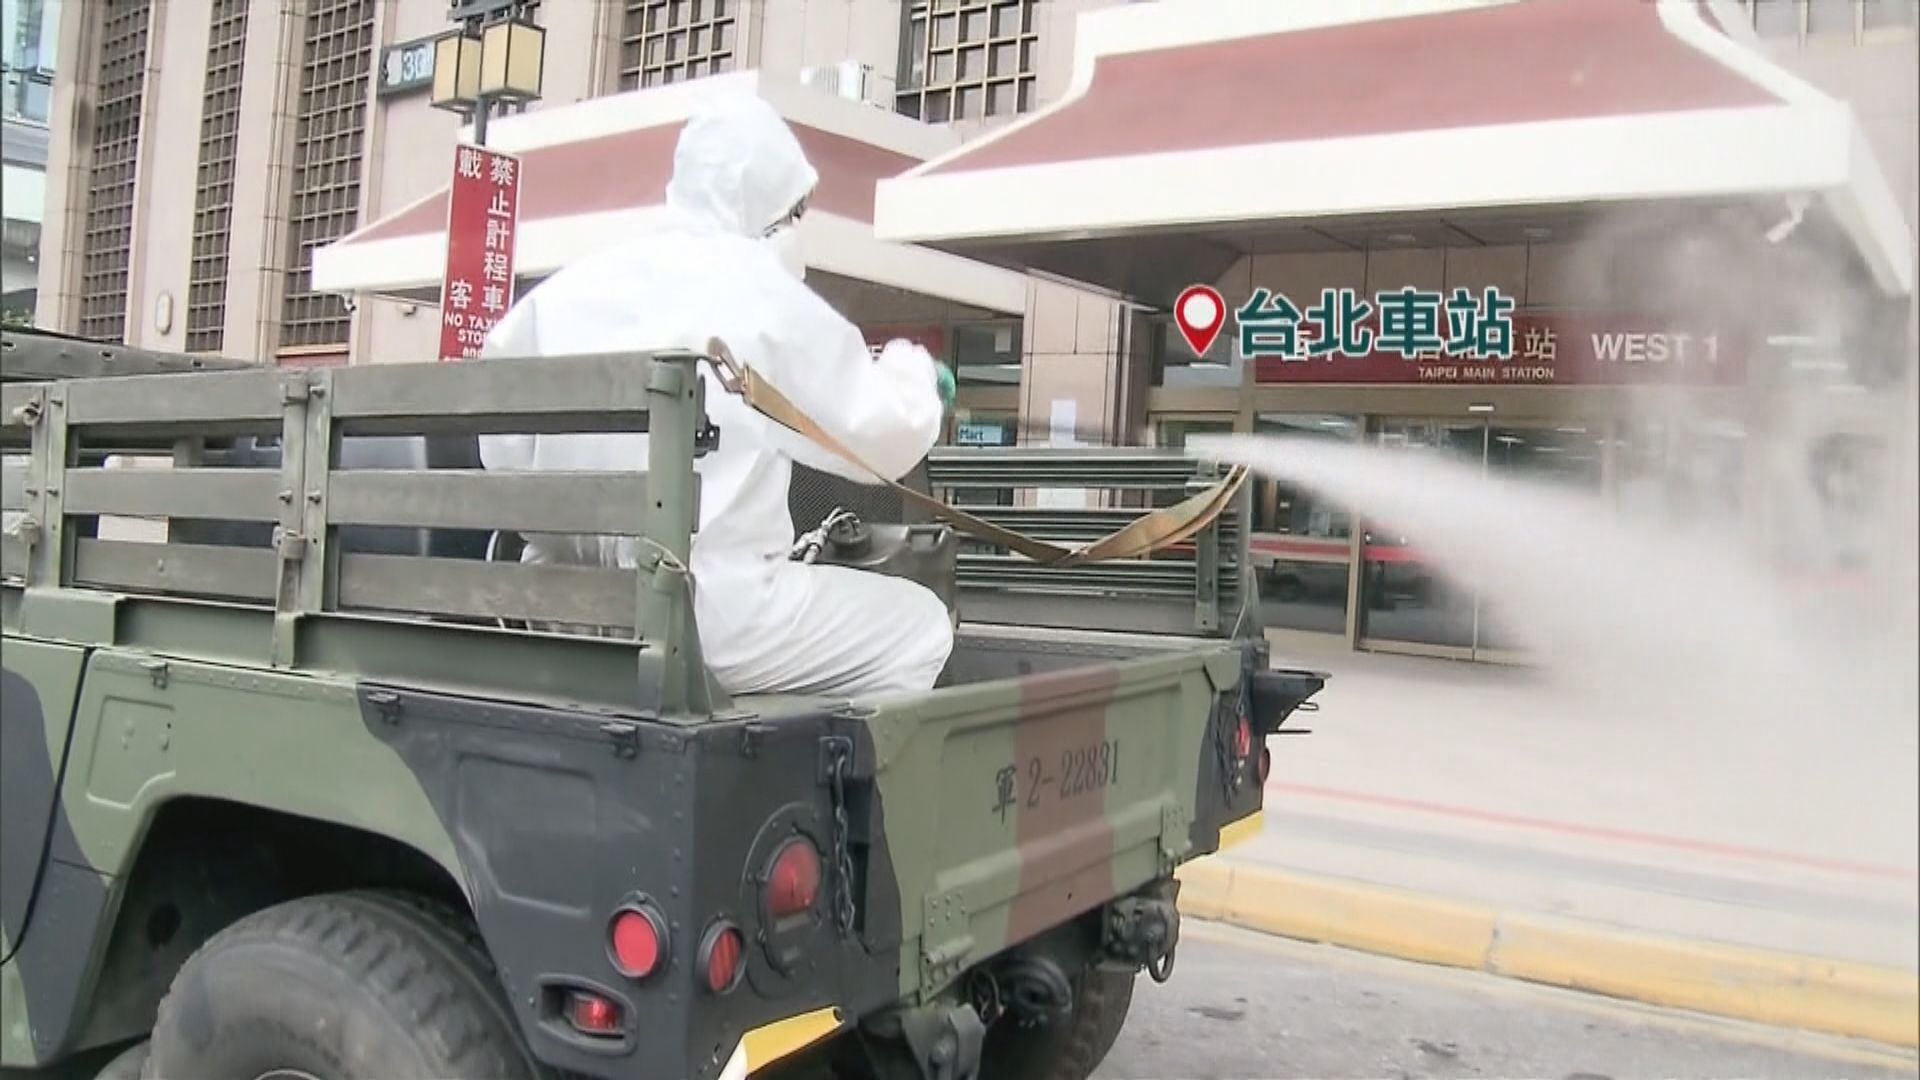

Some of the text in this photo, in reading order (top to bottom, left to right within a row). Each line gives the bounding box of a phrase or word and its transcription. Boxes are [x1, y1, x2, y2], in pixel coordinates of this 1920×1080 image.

[481, 155, 514, 313] 禁止計程車
[444, 312, 497, 330] NO TAX
[457, 328, 487, 345] STO
[1591, 332, 1690, 362] WEST
[1703, 334, 1719, 361] 1
[1418, 366, 1555, 379] TAIPEI MAIN STATION
[960, 427, 984, 442] Mart
[992, 739, 1119, 825] 軍 2-22831
